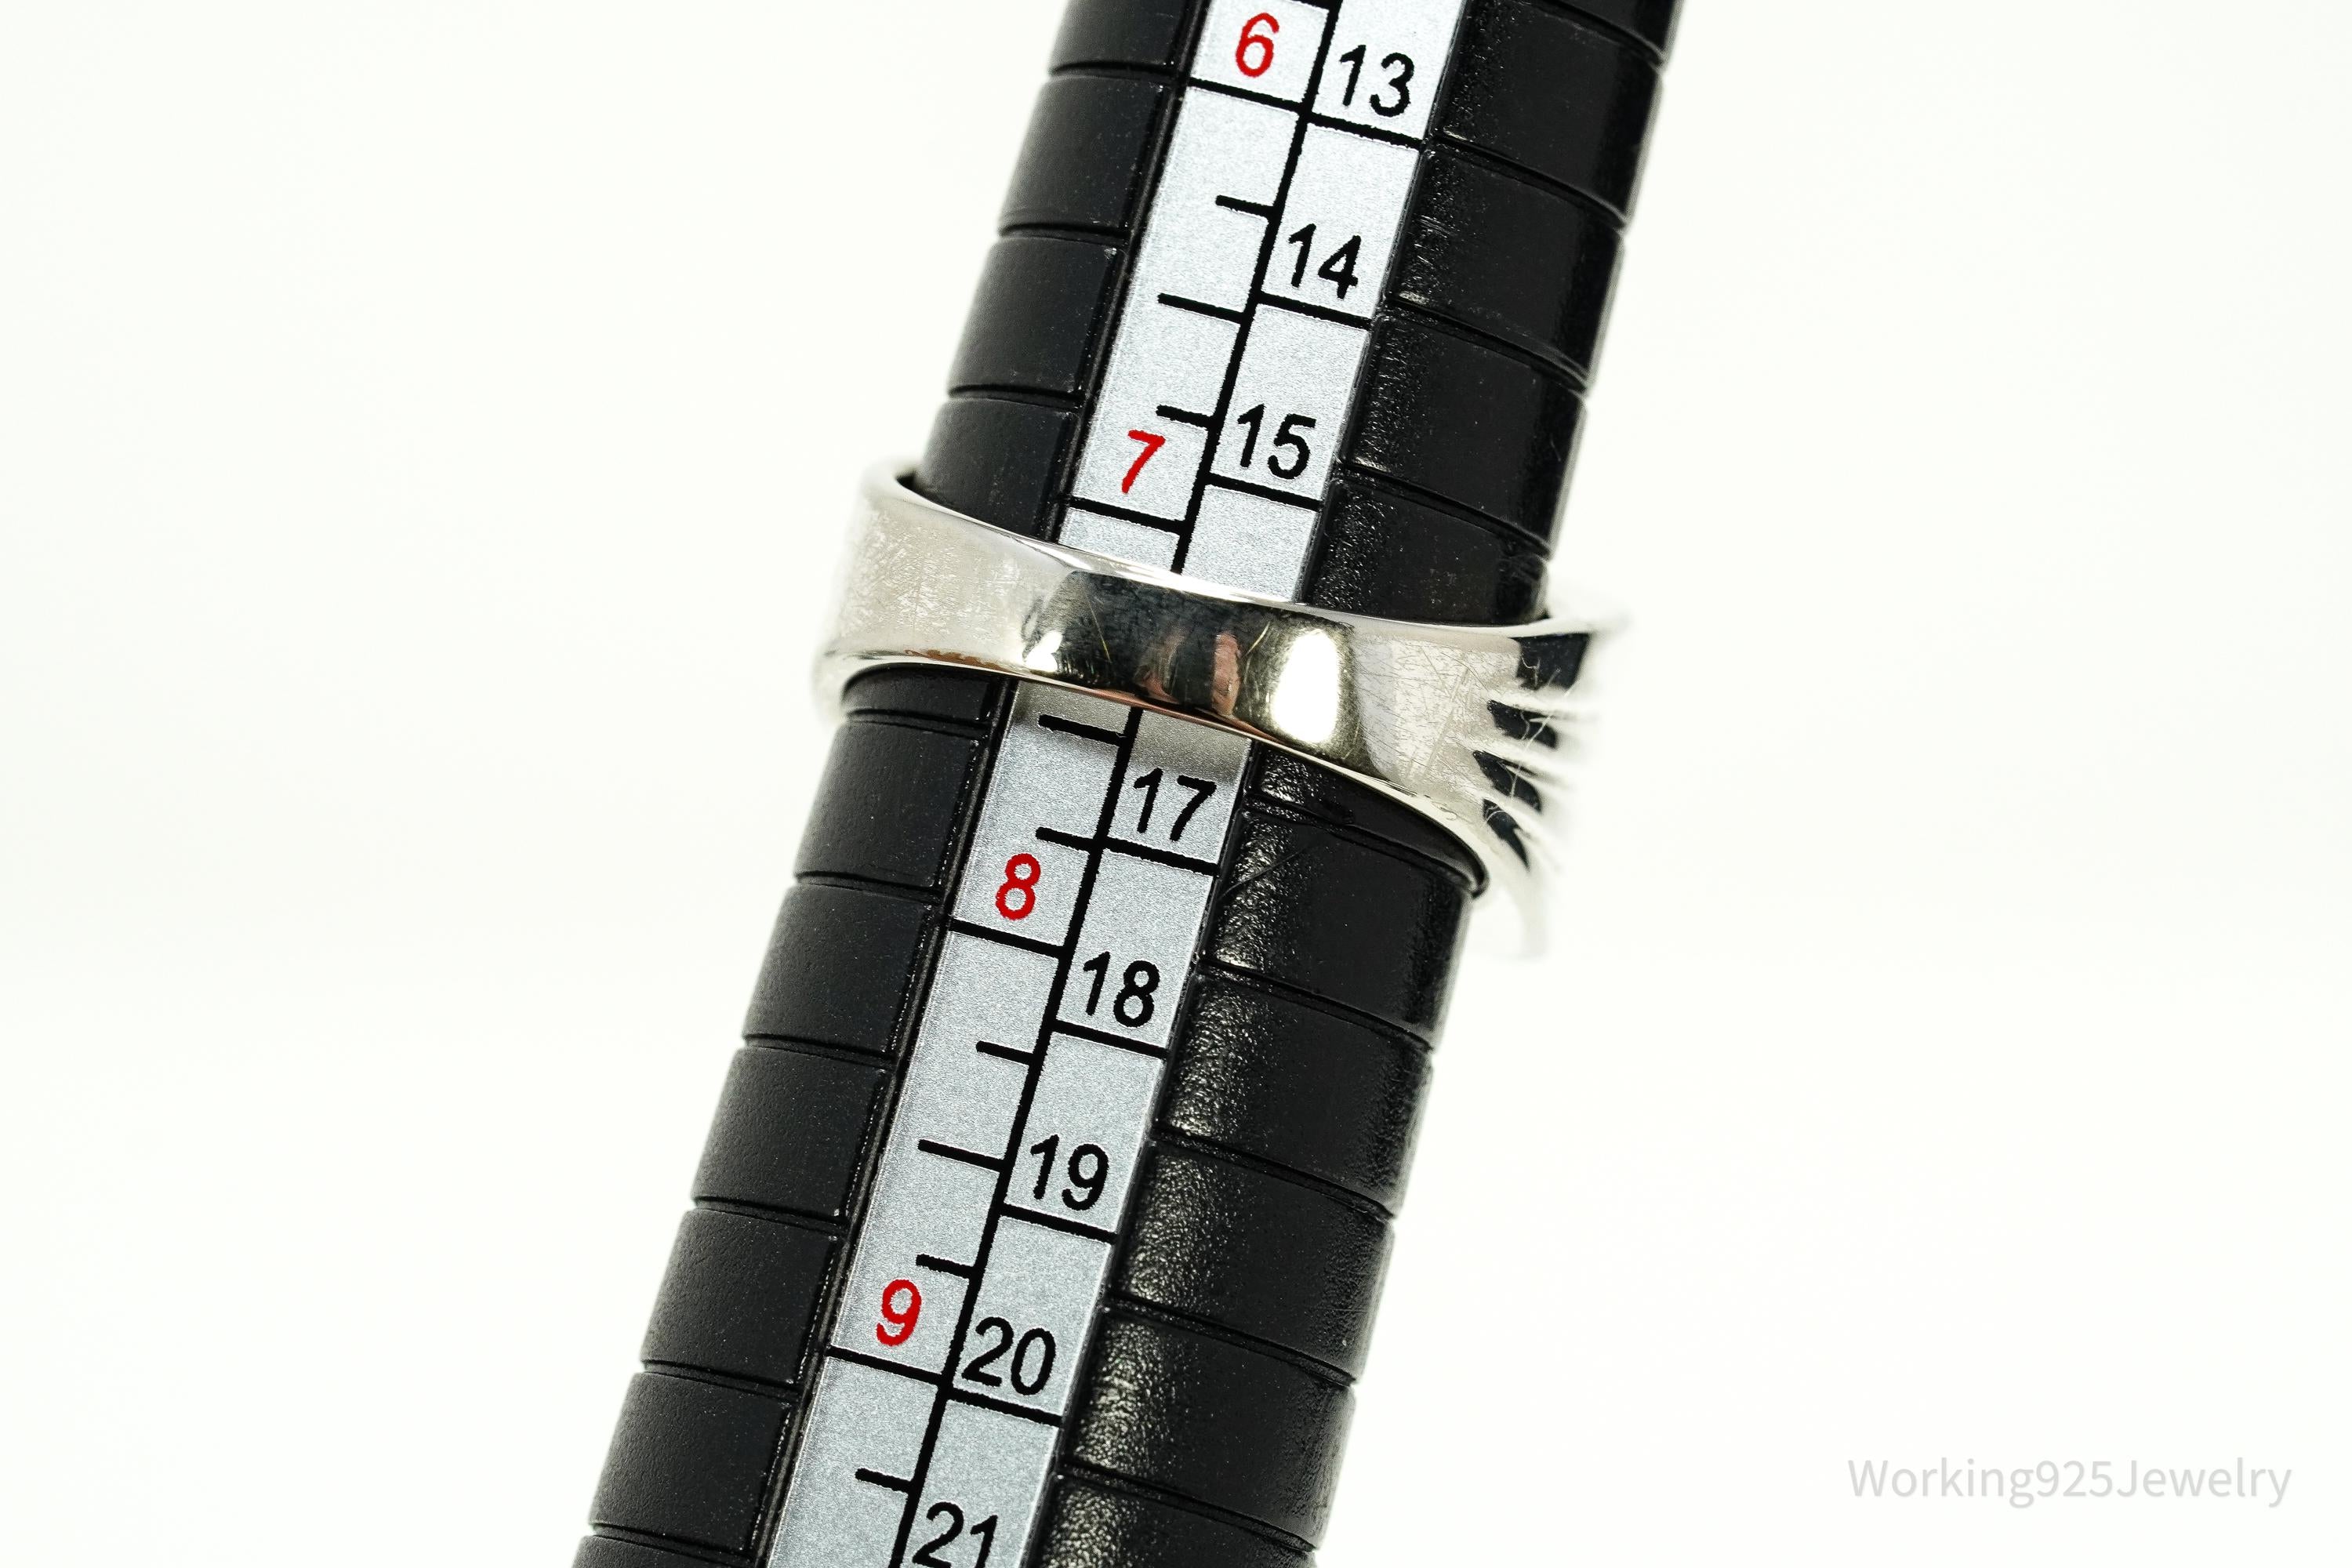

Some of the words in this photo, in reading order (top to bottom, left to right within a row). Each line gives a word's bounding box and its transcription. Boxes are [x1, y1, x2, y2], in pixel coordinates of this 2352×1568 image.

[1236, 13, 1280, 78] 6
[1340, 45, 1414, 118] 13
[1289, 223, 1362, 299] 14
[1122, 429, 1166, 494] 7
[1237, 404, 1316, 480] 15
[1134, 768, 1217, 843] 17
[996, 853, 1041, 921] 8
[1083, 952, 1160, 1029] 18
[1030, 1134, 1109, 1212] 19
[876, 1279, 922, 1347] 9
[961, 1317, 1057, 1396] 20
[913, 1502, 1000, 1568] 21
